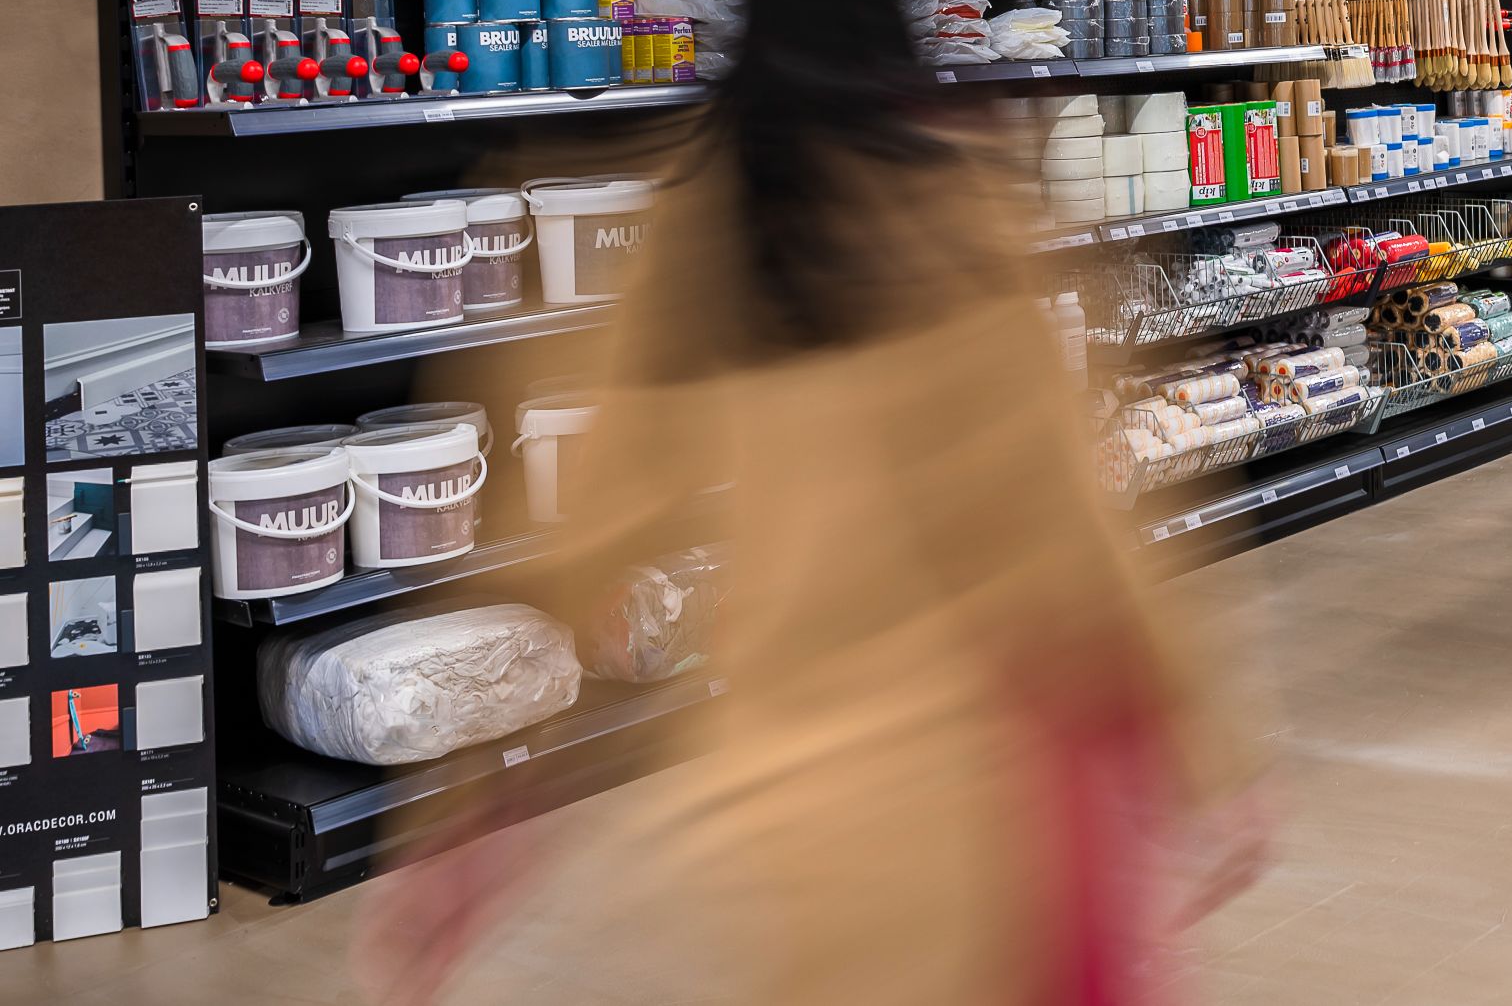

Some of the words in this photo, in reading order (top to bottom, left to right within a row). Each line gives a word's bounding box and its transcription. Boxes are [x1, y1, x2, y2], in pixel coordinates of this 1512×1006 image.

[490, 44, 513, 52] SEALER
[578, 40, 601, 48] SEALER
[1199, 186, 1216, 198] kip
[211, 262, 292, 290] MUUR
[249, 283, 293, 297] KALKVERF
[400, 474, 472, 509] MUUR
[258, 500, 339, 538] MUUR
